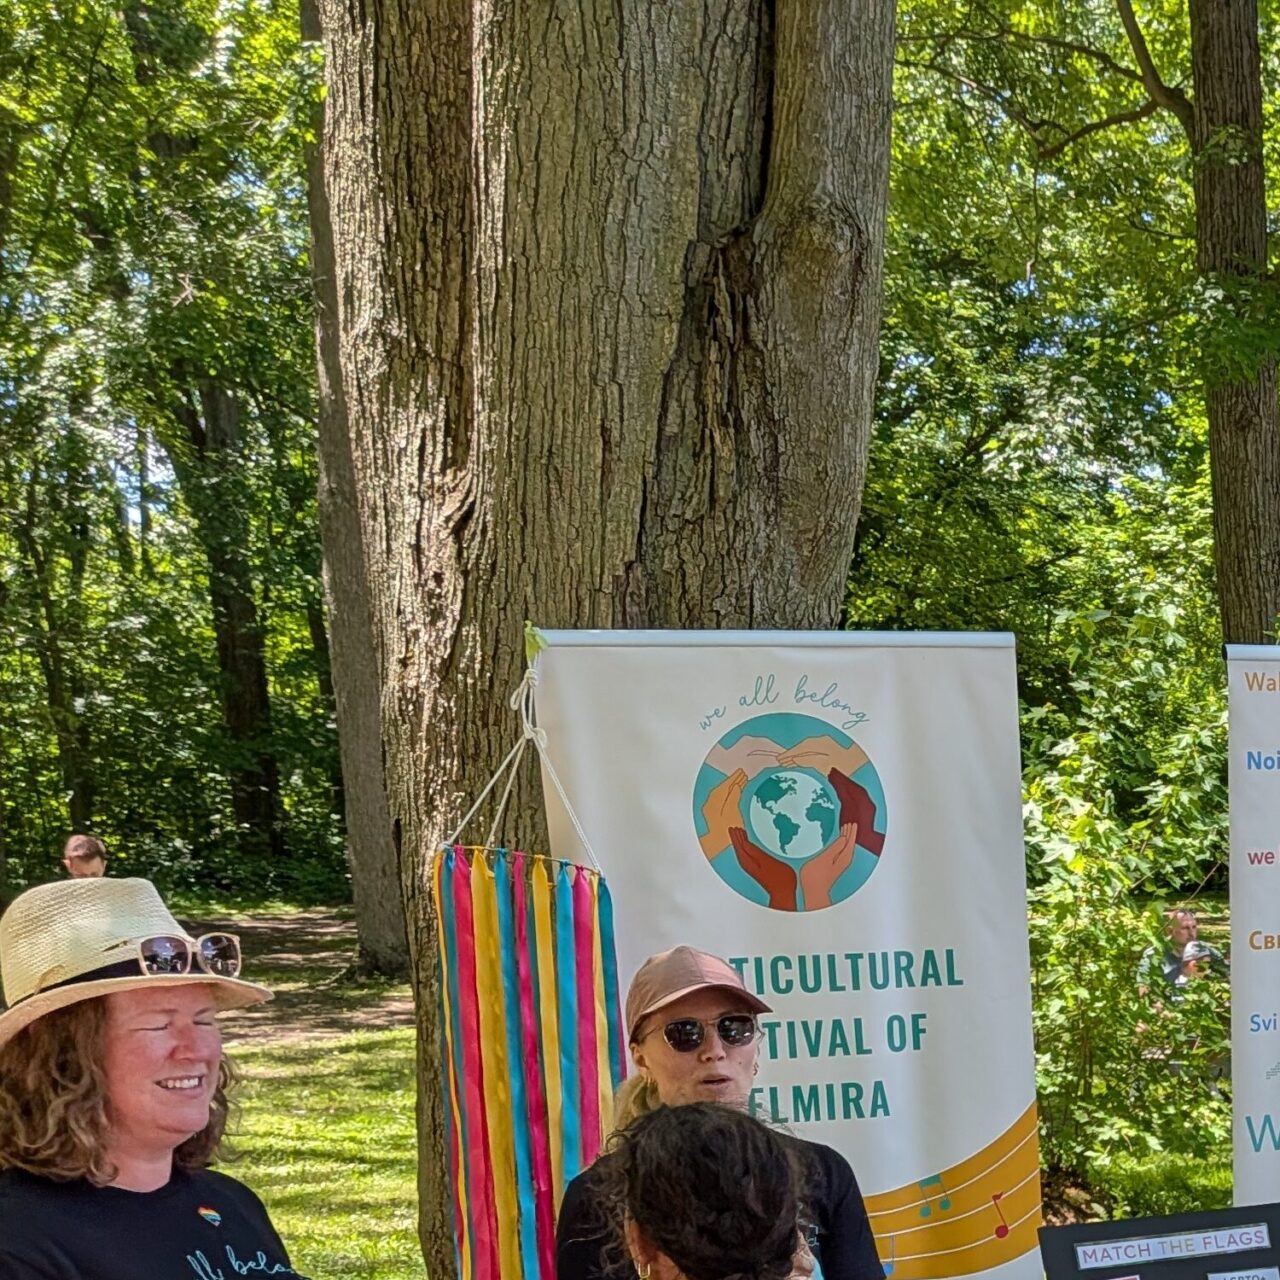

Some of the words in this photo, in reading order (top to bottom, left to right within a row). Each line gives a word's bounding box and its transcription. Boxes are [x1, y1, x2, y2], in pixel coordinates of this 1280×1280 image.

[699, 705, 727, 730] we
[739, 673, 780, 707] all
[794, 674, 870, 729] belong
[1248, 850, 1275, 866] we
[729, 948, 964, 996] TICULTURAL
[761, 1017, 873, 1060] TIVAL
[886, 1012, 928, 1053] OF
[1250, 1015, 1277, 1033] Svi
[1083, 1243, 1151, 1264] MATCH
[1157, 1238, 1195, 1256] THE
[1202, 1229, 1266, 1251] FLAGS
